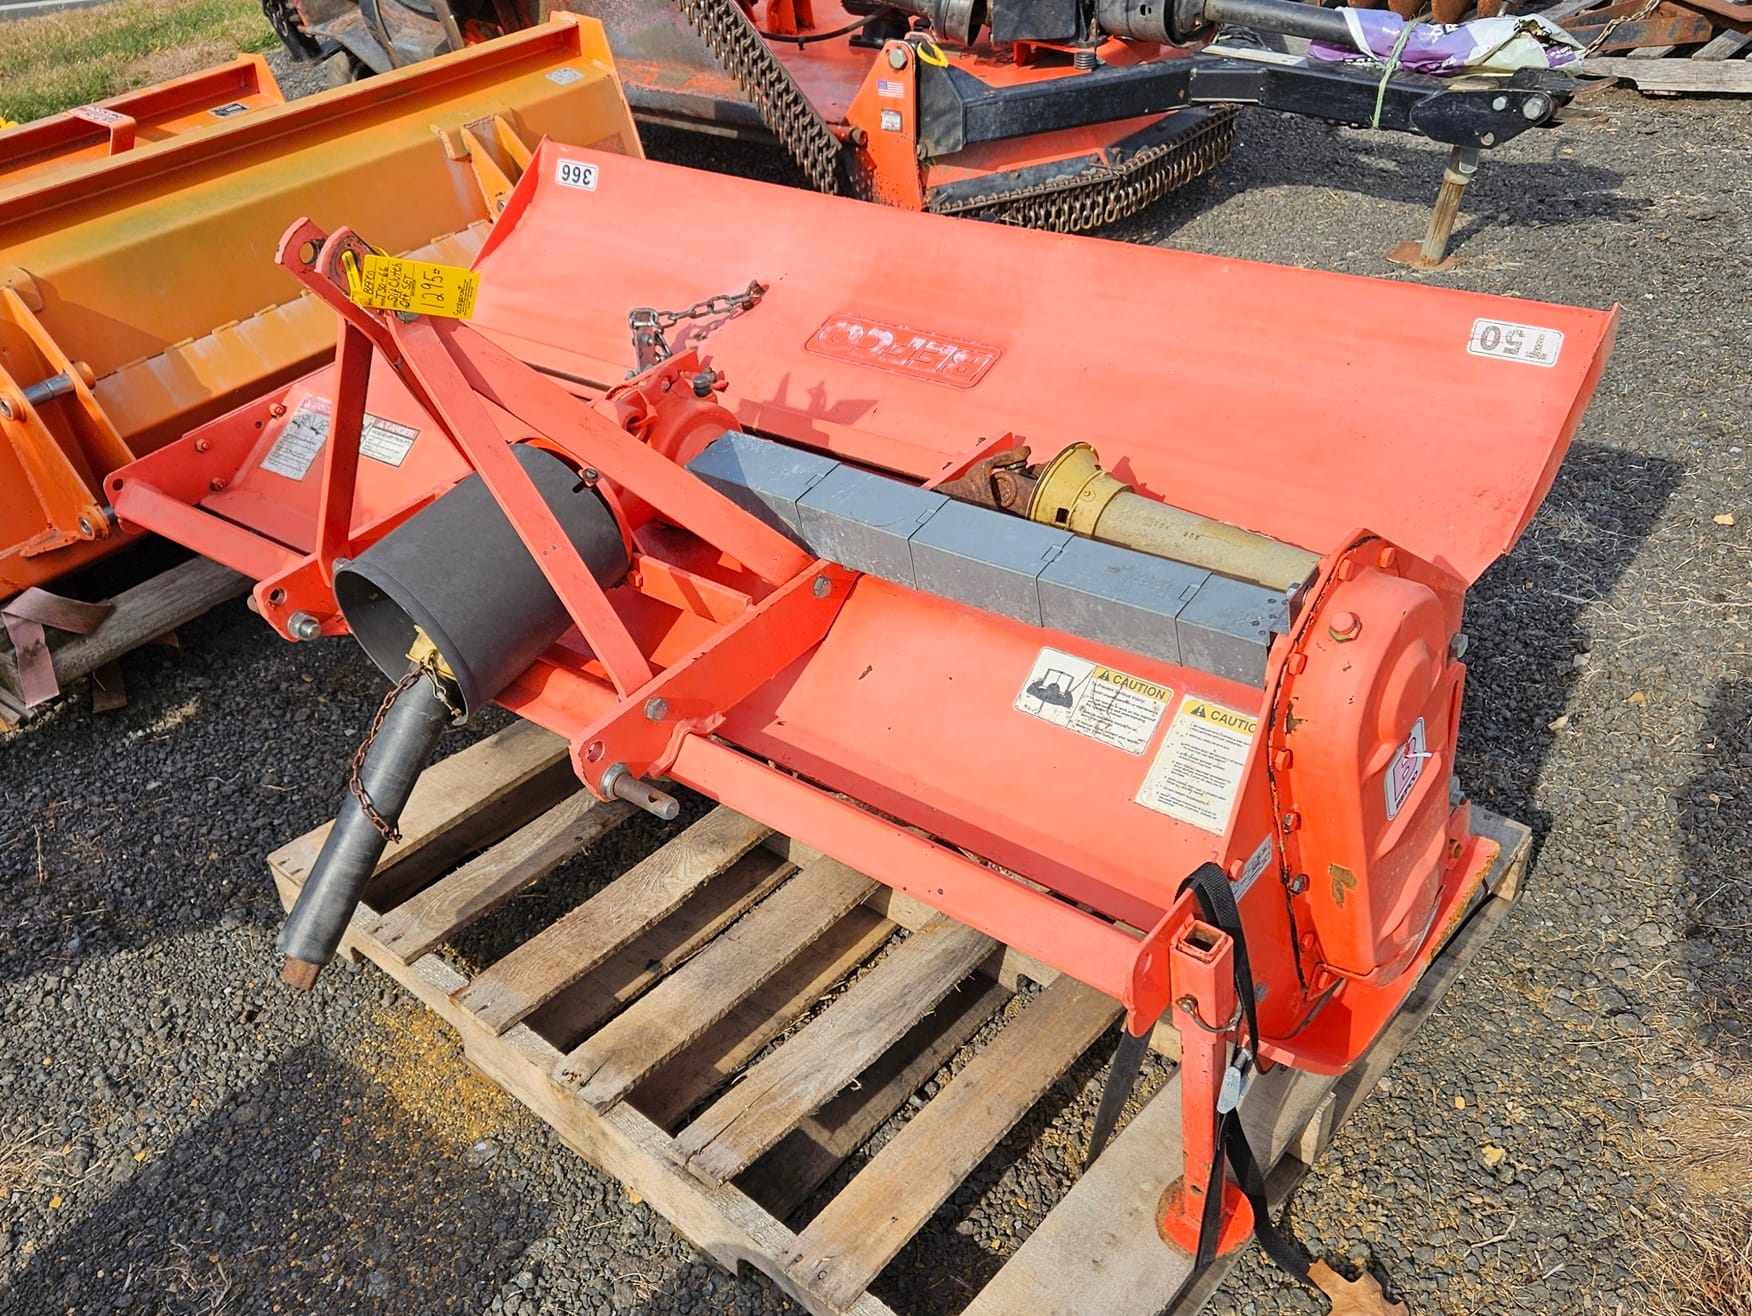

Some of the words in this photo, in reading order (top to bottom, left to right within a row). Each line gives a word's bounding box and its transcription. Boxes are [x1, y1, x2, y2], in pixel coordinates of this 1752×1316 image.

[562, 165, 591, 186] 366
[818, 321, 994, 382] BEFCO
[1113, 675, 1166, 700] CAUTION
[1210, 710, 1257, 733] CAUTIO
